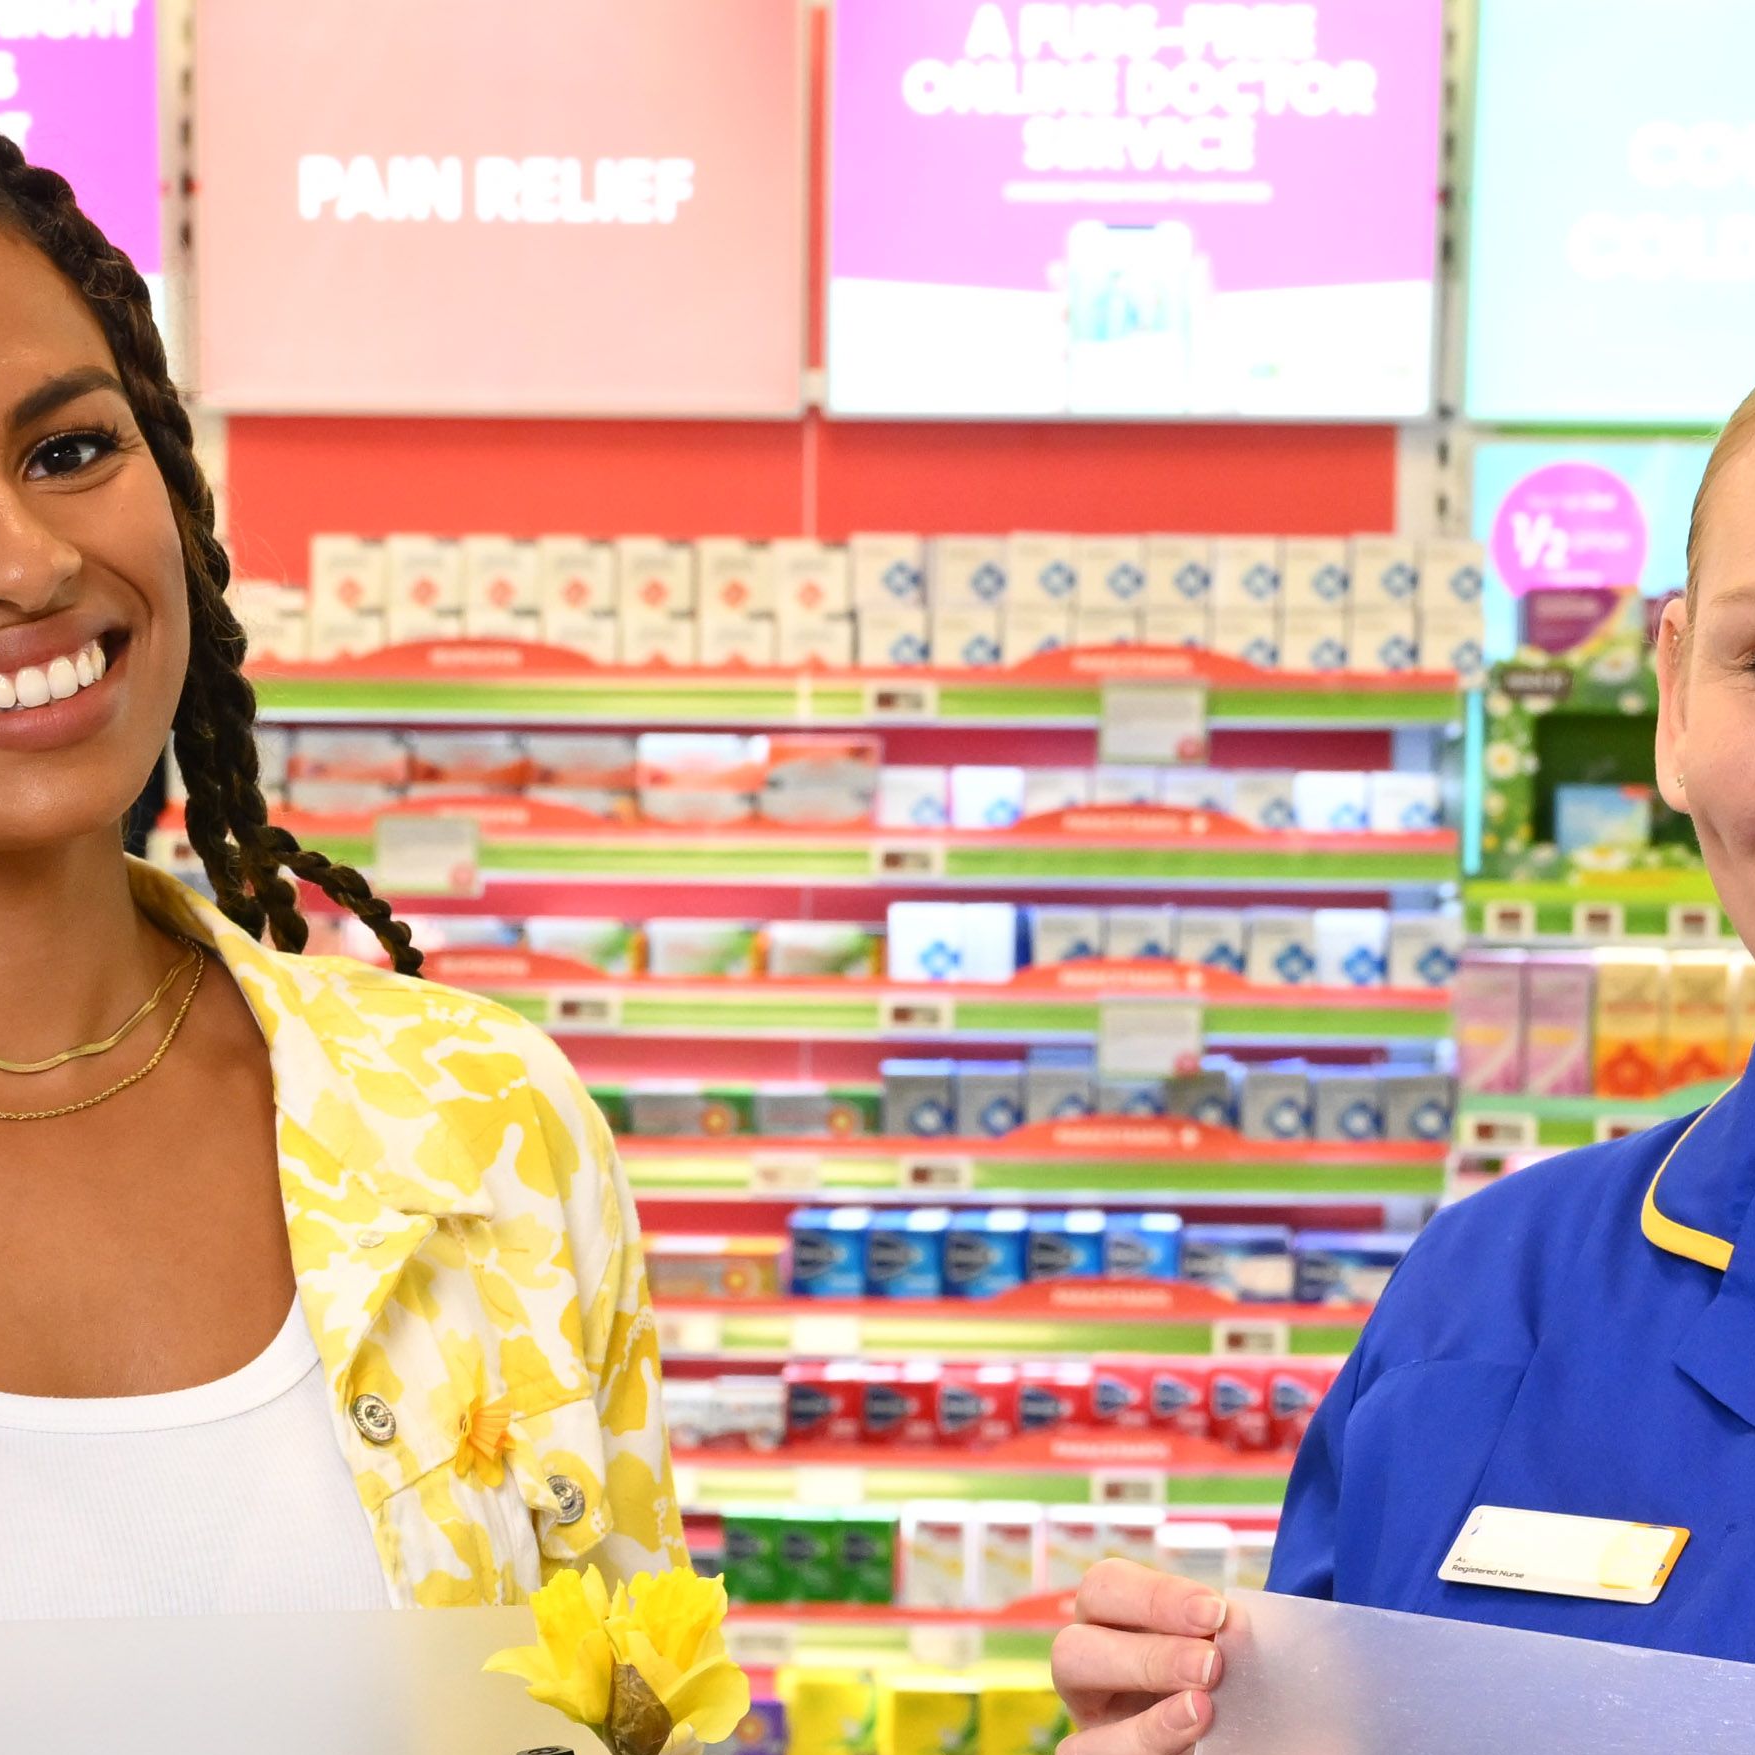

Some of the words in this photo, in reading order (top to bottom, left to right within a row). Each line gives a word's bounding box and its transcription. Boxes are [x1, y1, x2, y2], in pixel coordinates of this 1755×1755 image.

[1128, 61, 1376, 115] DOCTOR
[299, 157, 462, 220] PAIN
[476, 157, 695, 222] RELIEF
[1451, 1563, 1498, 1577] Registered
[1499, 1569, 1525, 1580] Nurse
